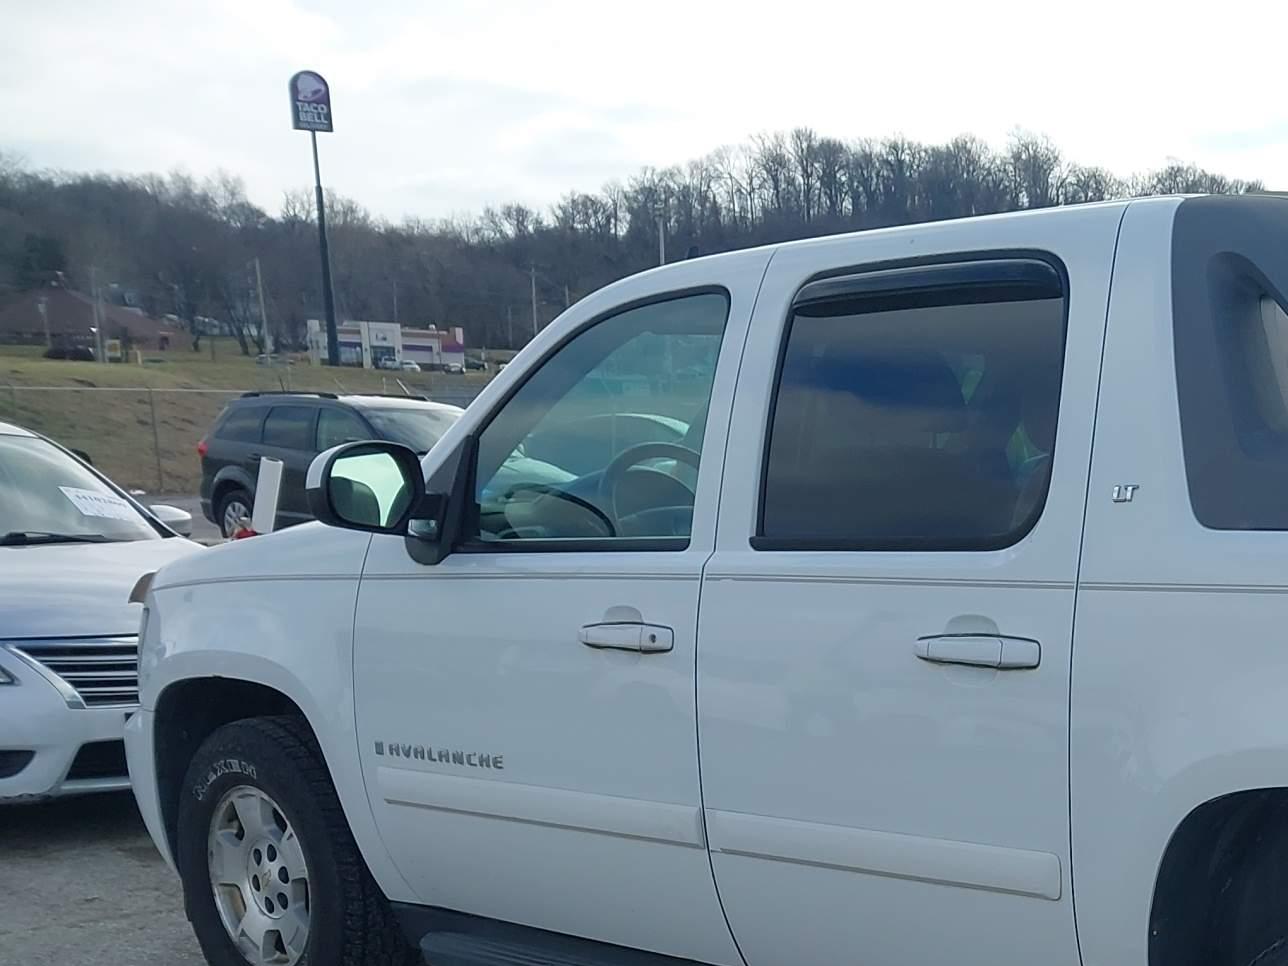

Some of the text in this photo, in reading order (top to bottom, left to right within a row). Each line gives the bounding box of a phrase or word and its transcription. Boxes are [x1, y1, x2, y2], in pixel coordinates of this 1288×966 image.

[296, 101, 327, 113] TACO
[299, 111, 328, 123] BELL
[1112, 485, 1140, 503] LT
[388, 743, 505, 770] AVALANCHE
